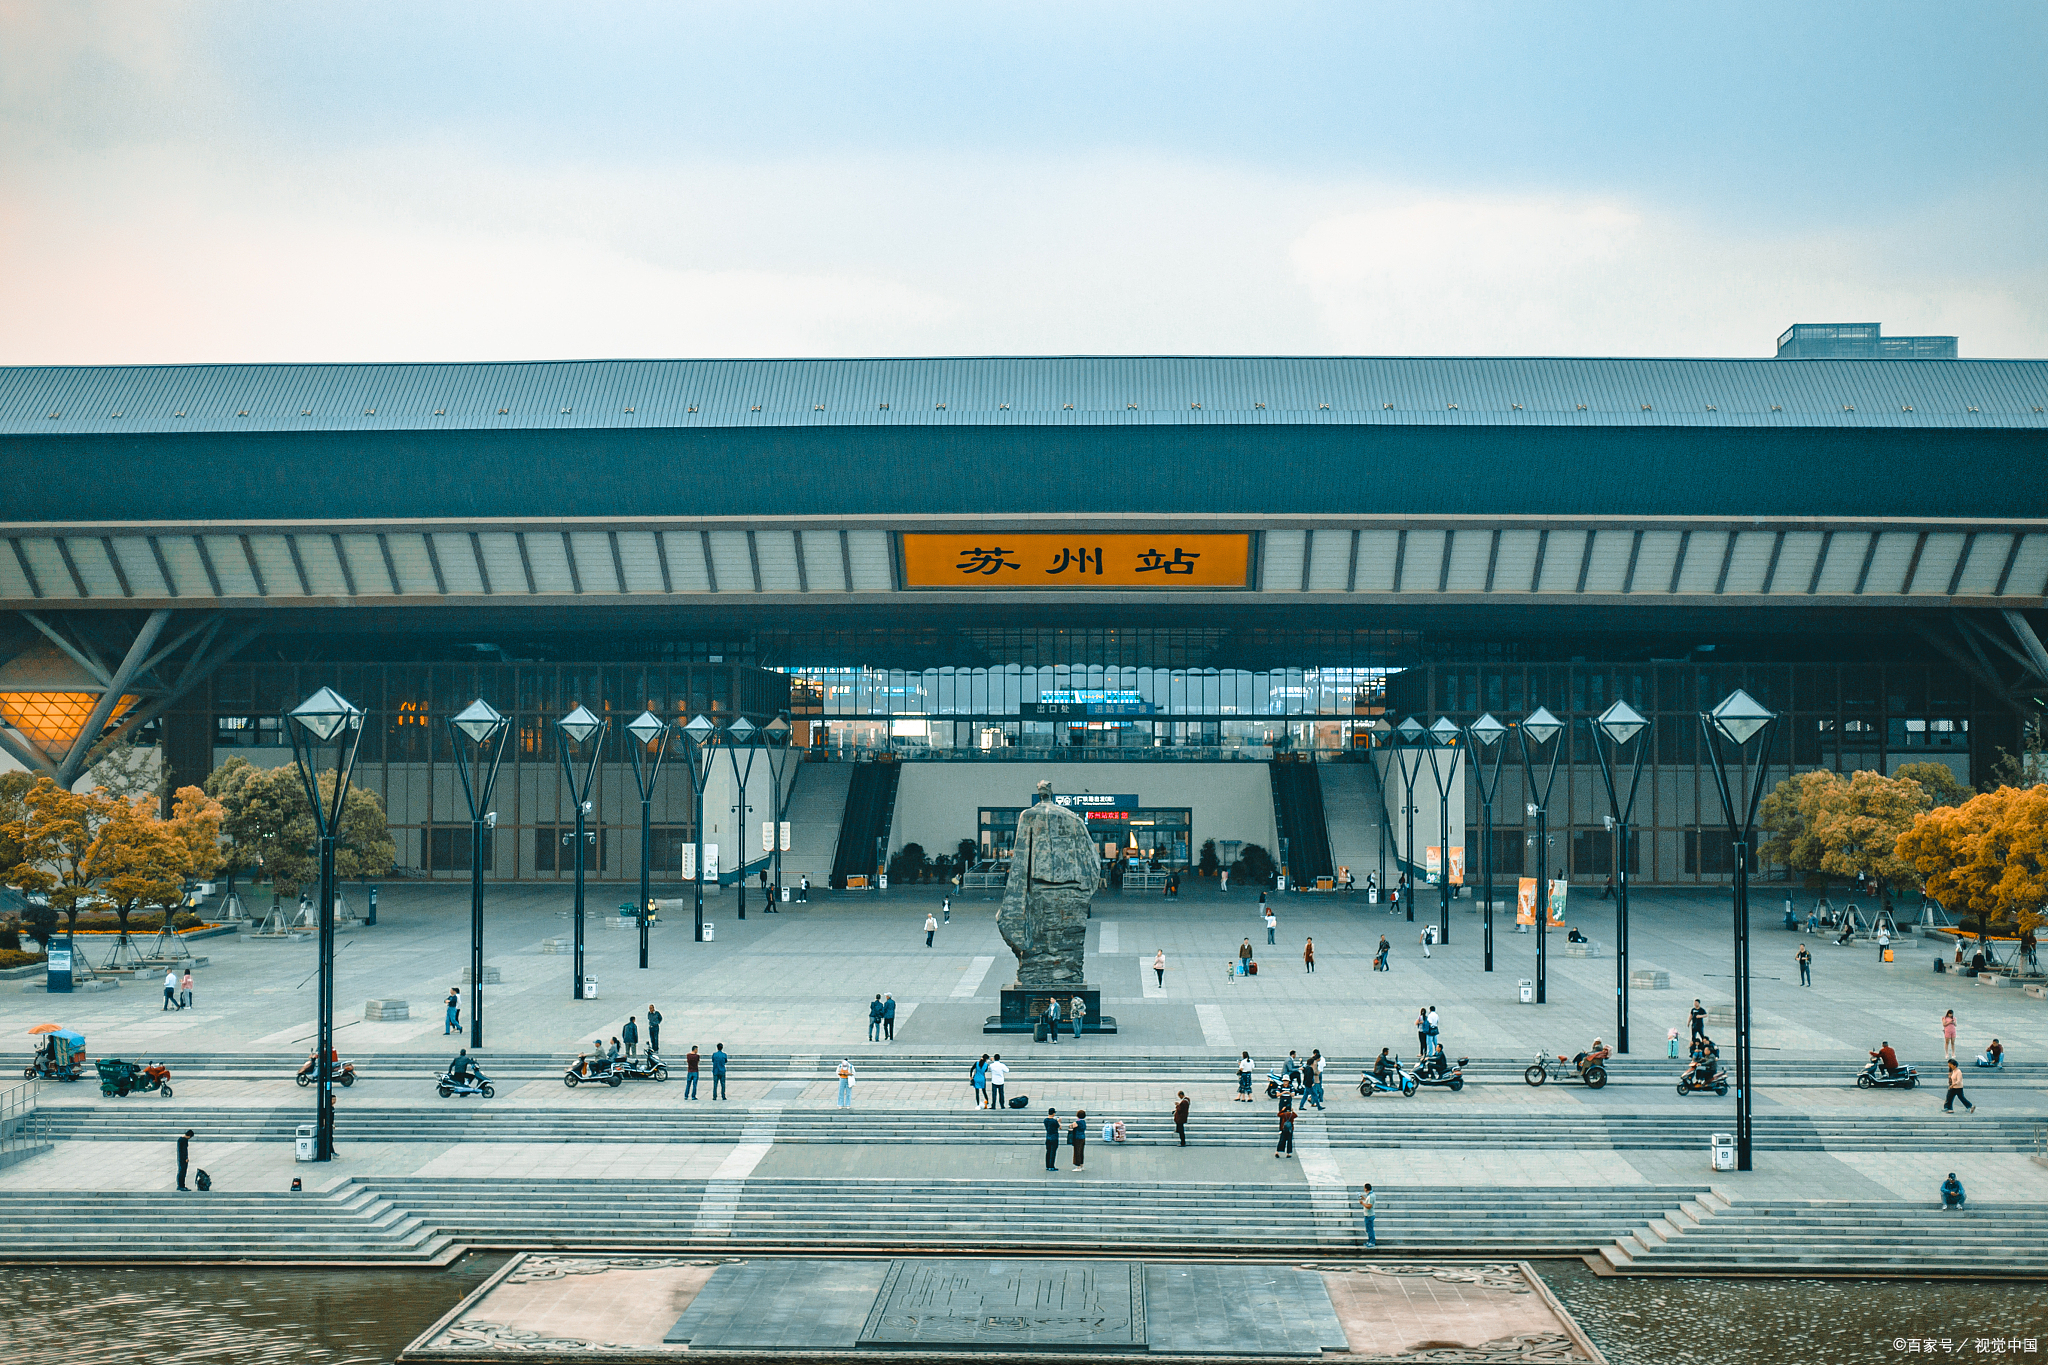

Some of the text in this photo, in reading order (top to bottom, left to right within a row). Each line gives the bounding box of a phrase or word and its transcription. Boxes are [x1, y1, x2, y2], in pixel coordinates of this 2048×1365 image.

[955, 547, 1201, 576] 苏州站
[1036, 704, 1148, 714] 出口处 进站至一楼
